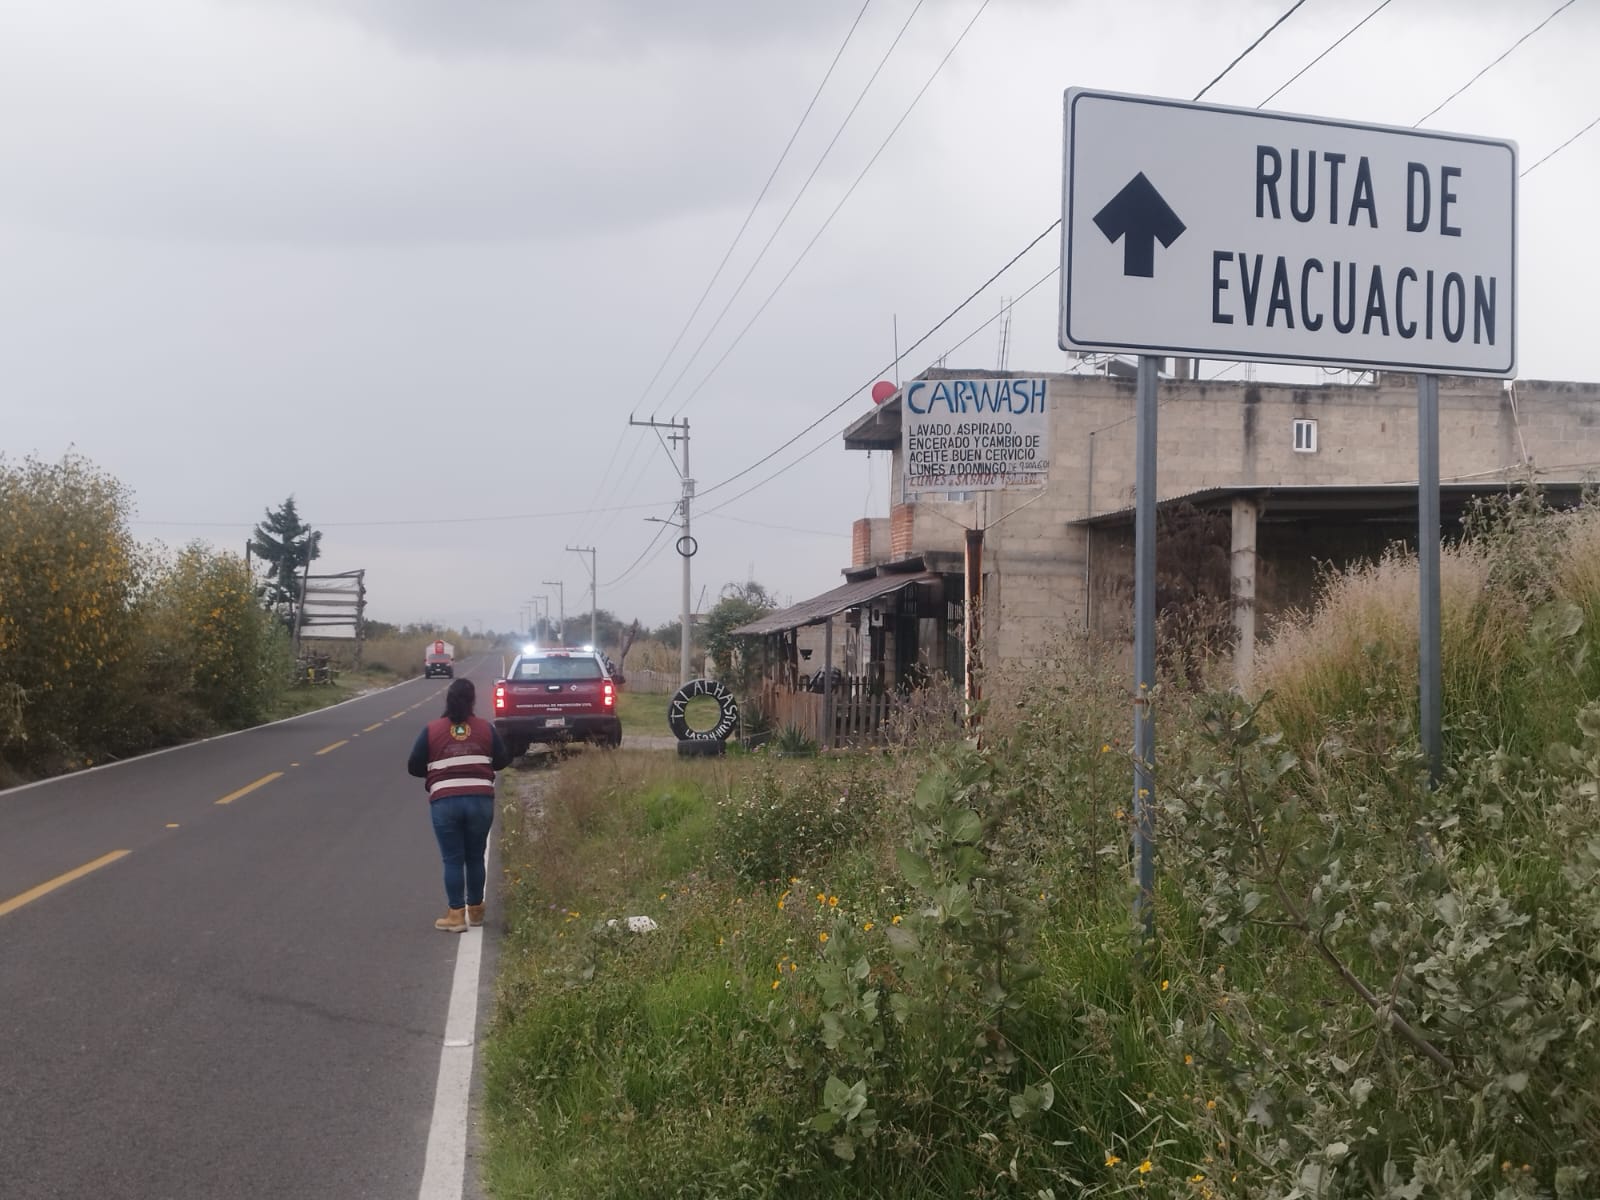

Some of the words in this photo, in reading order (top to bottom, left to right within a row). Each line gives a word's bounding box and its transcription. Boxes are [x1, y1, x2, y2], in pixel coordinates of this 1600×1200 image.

[1256, 145, 1378, 229] RUTA
[1406, 162, 1462, 237] DE
[1212, 250, 1497, 347] EVACUACION
[907, 379, 1046, 414] CAR-WASH
[909, 437, 970, 450] ENCERADO
[974, 437, 981, 448] Y
[982, 435, 1022, 448] CAMBIO
[1025, 435, 1040, 448] DE
[910, 450, 948, 463] ACEITE
[952, 449, 981, 462] BUEN
[985, 448, 1035, 461] CERVICIO
[909, 463, 946, 476] LUNES
[950, 463, 957, 475] A
